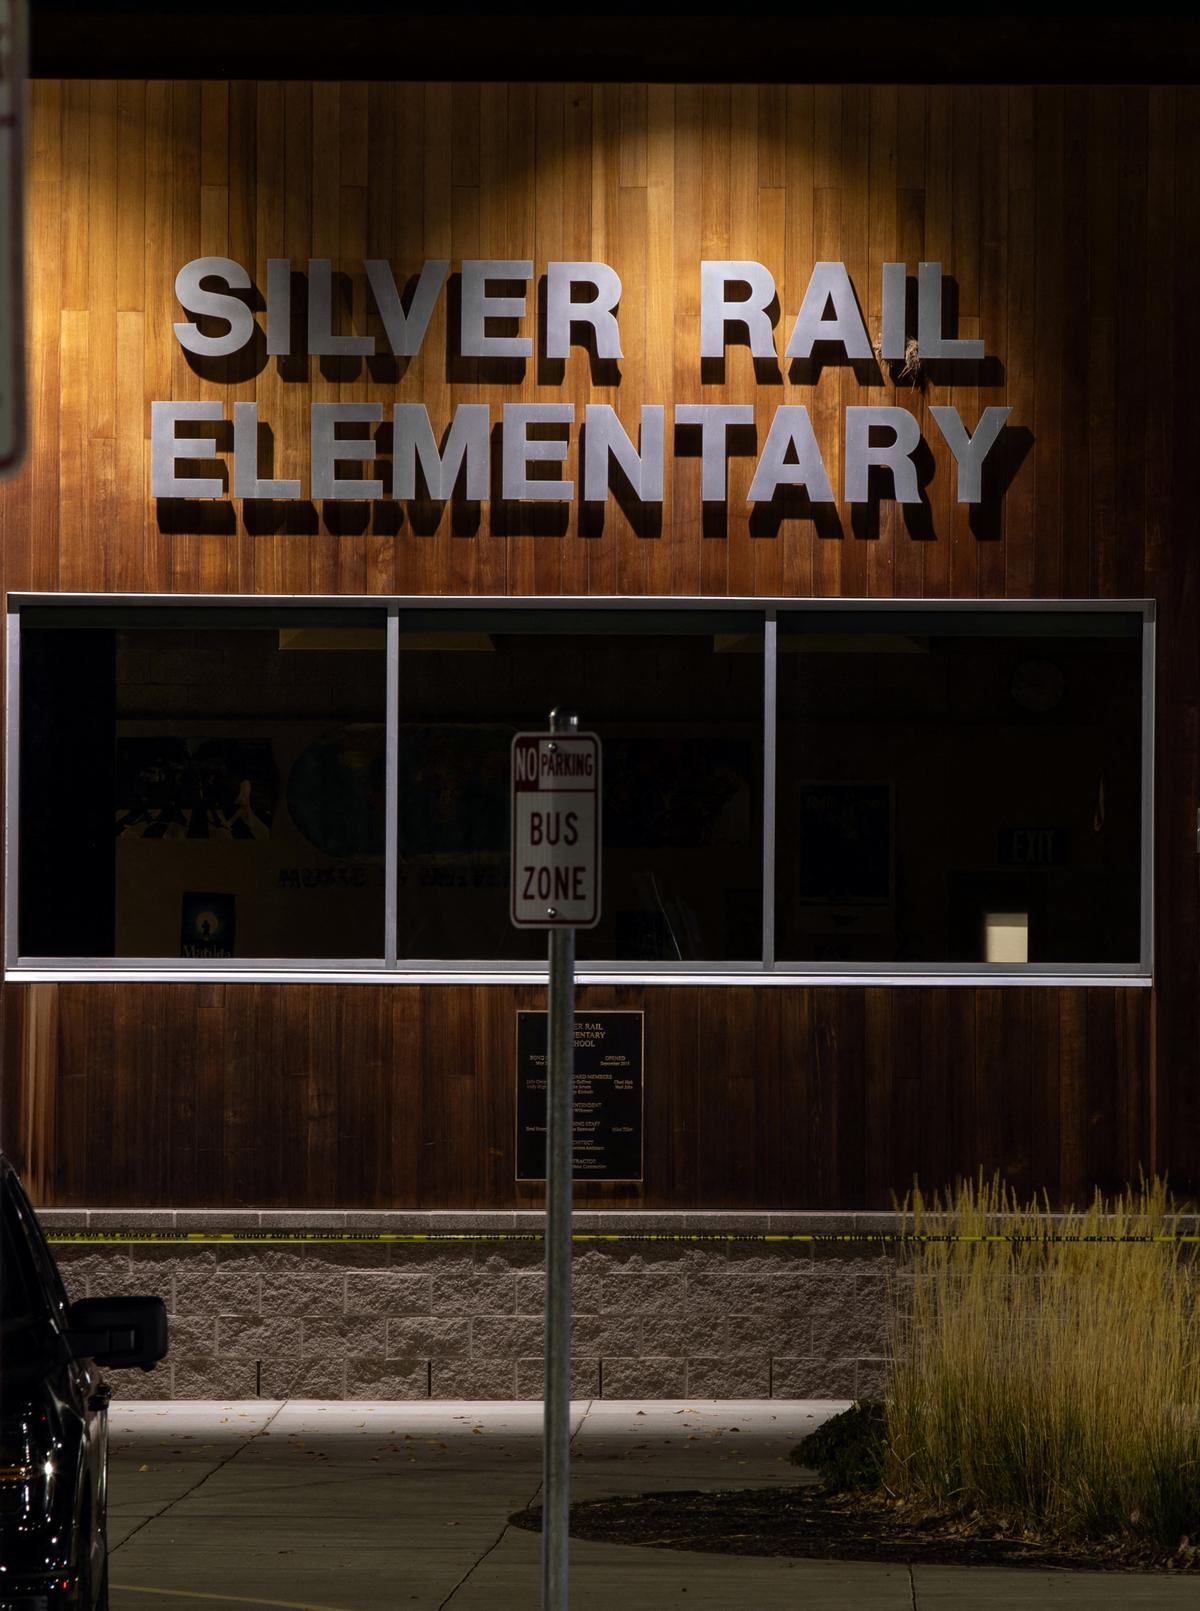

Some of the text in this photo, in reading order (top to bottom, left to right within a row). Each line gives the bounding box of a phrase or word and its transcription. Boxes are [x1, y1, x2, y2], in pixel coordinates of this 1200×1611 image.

[173, 256, 985, 361] SILVER RAIL
[151, 400, 1014, 505] ELEMENTARY
[516, 747, 593, 783] NO PARKING
[530, 811, 579, 846] BUS
[523, 866, 587, 900] ZONE
[574, 1040, 596, 1048] HOOL
[575, 1031, 606, 1039] ENTARY
